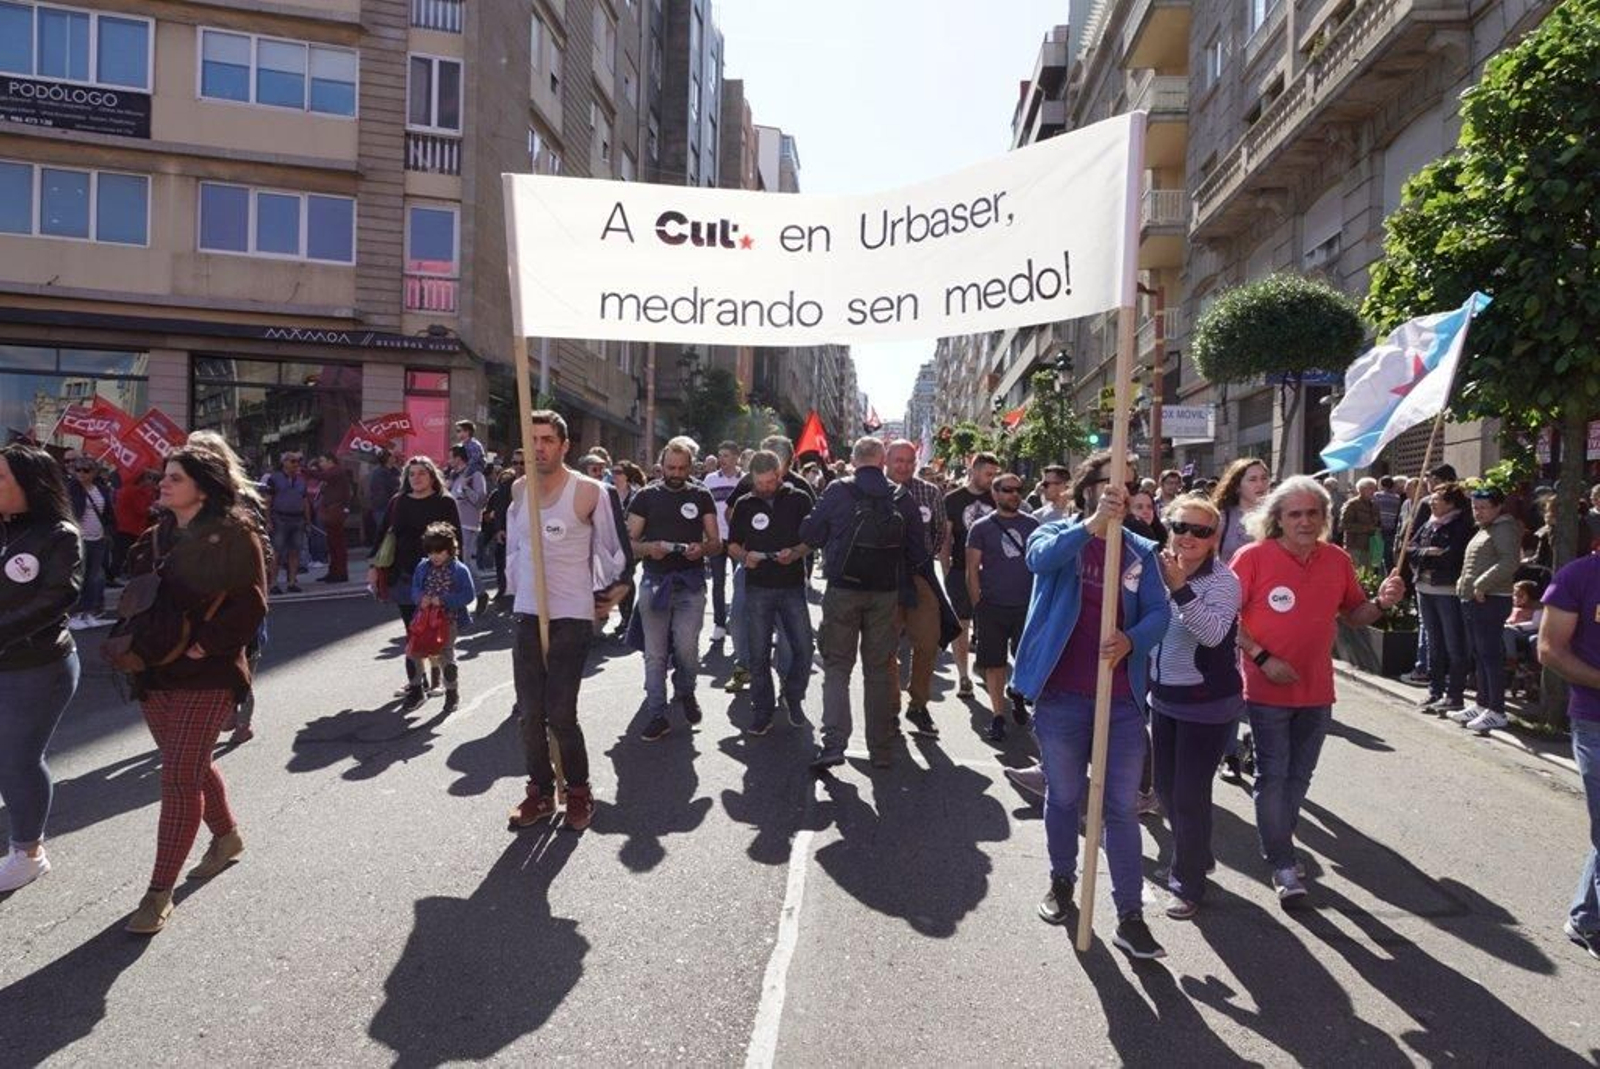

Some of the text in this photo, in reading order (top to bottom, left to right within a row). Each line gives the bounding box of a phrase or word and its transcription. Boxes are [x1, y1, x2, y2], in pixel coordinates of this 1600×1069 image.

[9, 81, 118, 107] PODÓLOGO
[600, 201, 635, 243] A
[780, 224, 831, 252] en
[860, 190, 1014, 250] Urbaser,
[600, 250, 1072, 328] medrando sen medo!
